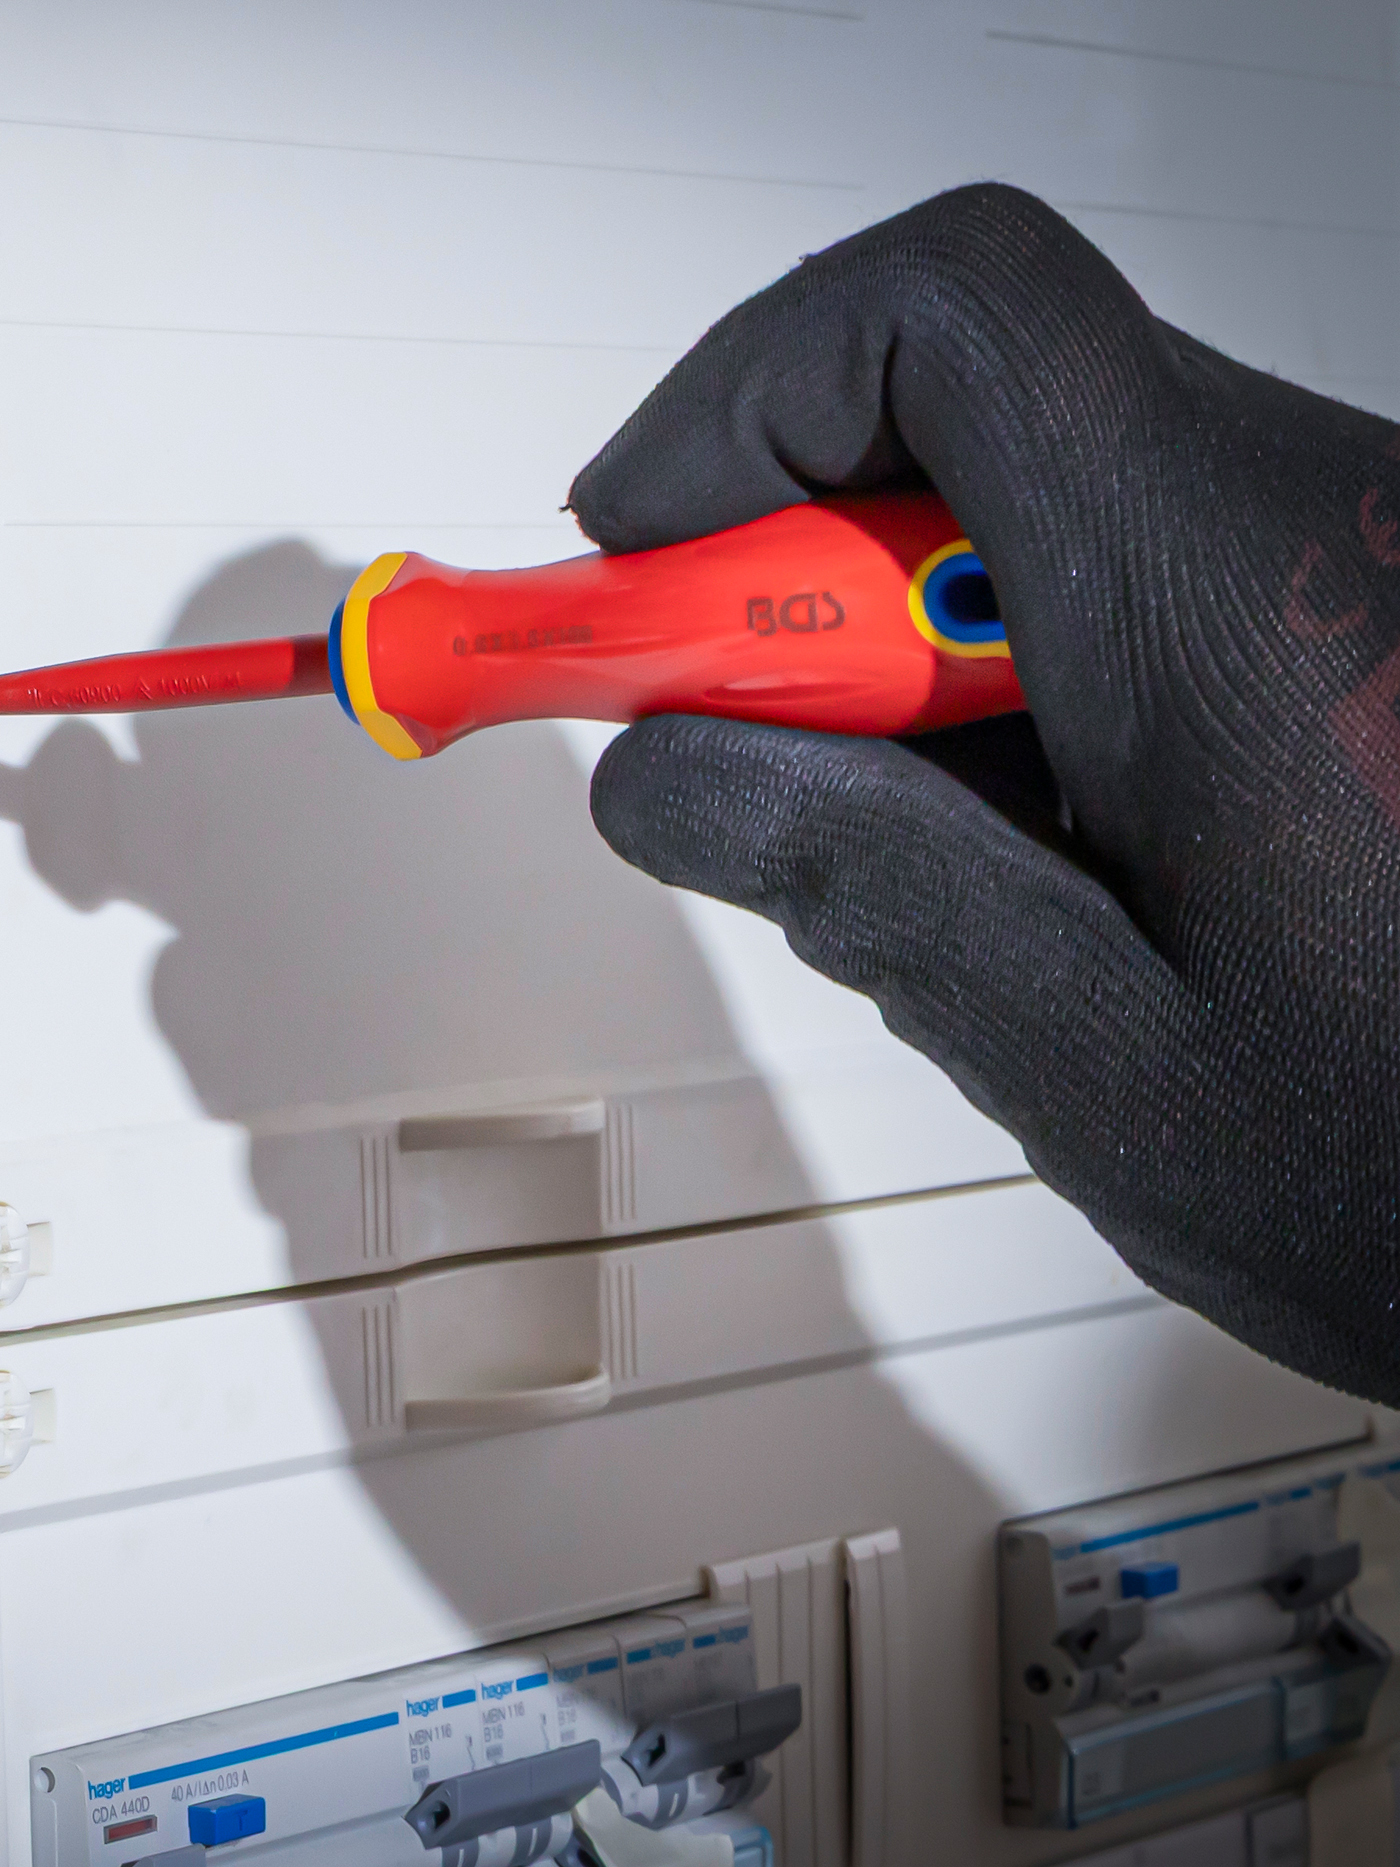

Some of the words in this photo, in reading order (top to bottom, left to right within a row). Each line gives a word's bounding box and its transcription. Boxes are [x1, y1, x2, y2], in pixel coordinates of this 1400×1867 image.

[481, 1679, 514, 1700] hager
[406, 1696, 440, 1717] hager
[87, 1776, 126, 1801] hager
[171, 1784, 184, 1802] 40
[241, 1768, 250, 1787] A
[92, 1803, 119, 1825] CDA
[120, 1796, 150, 1817] 440D
